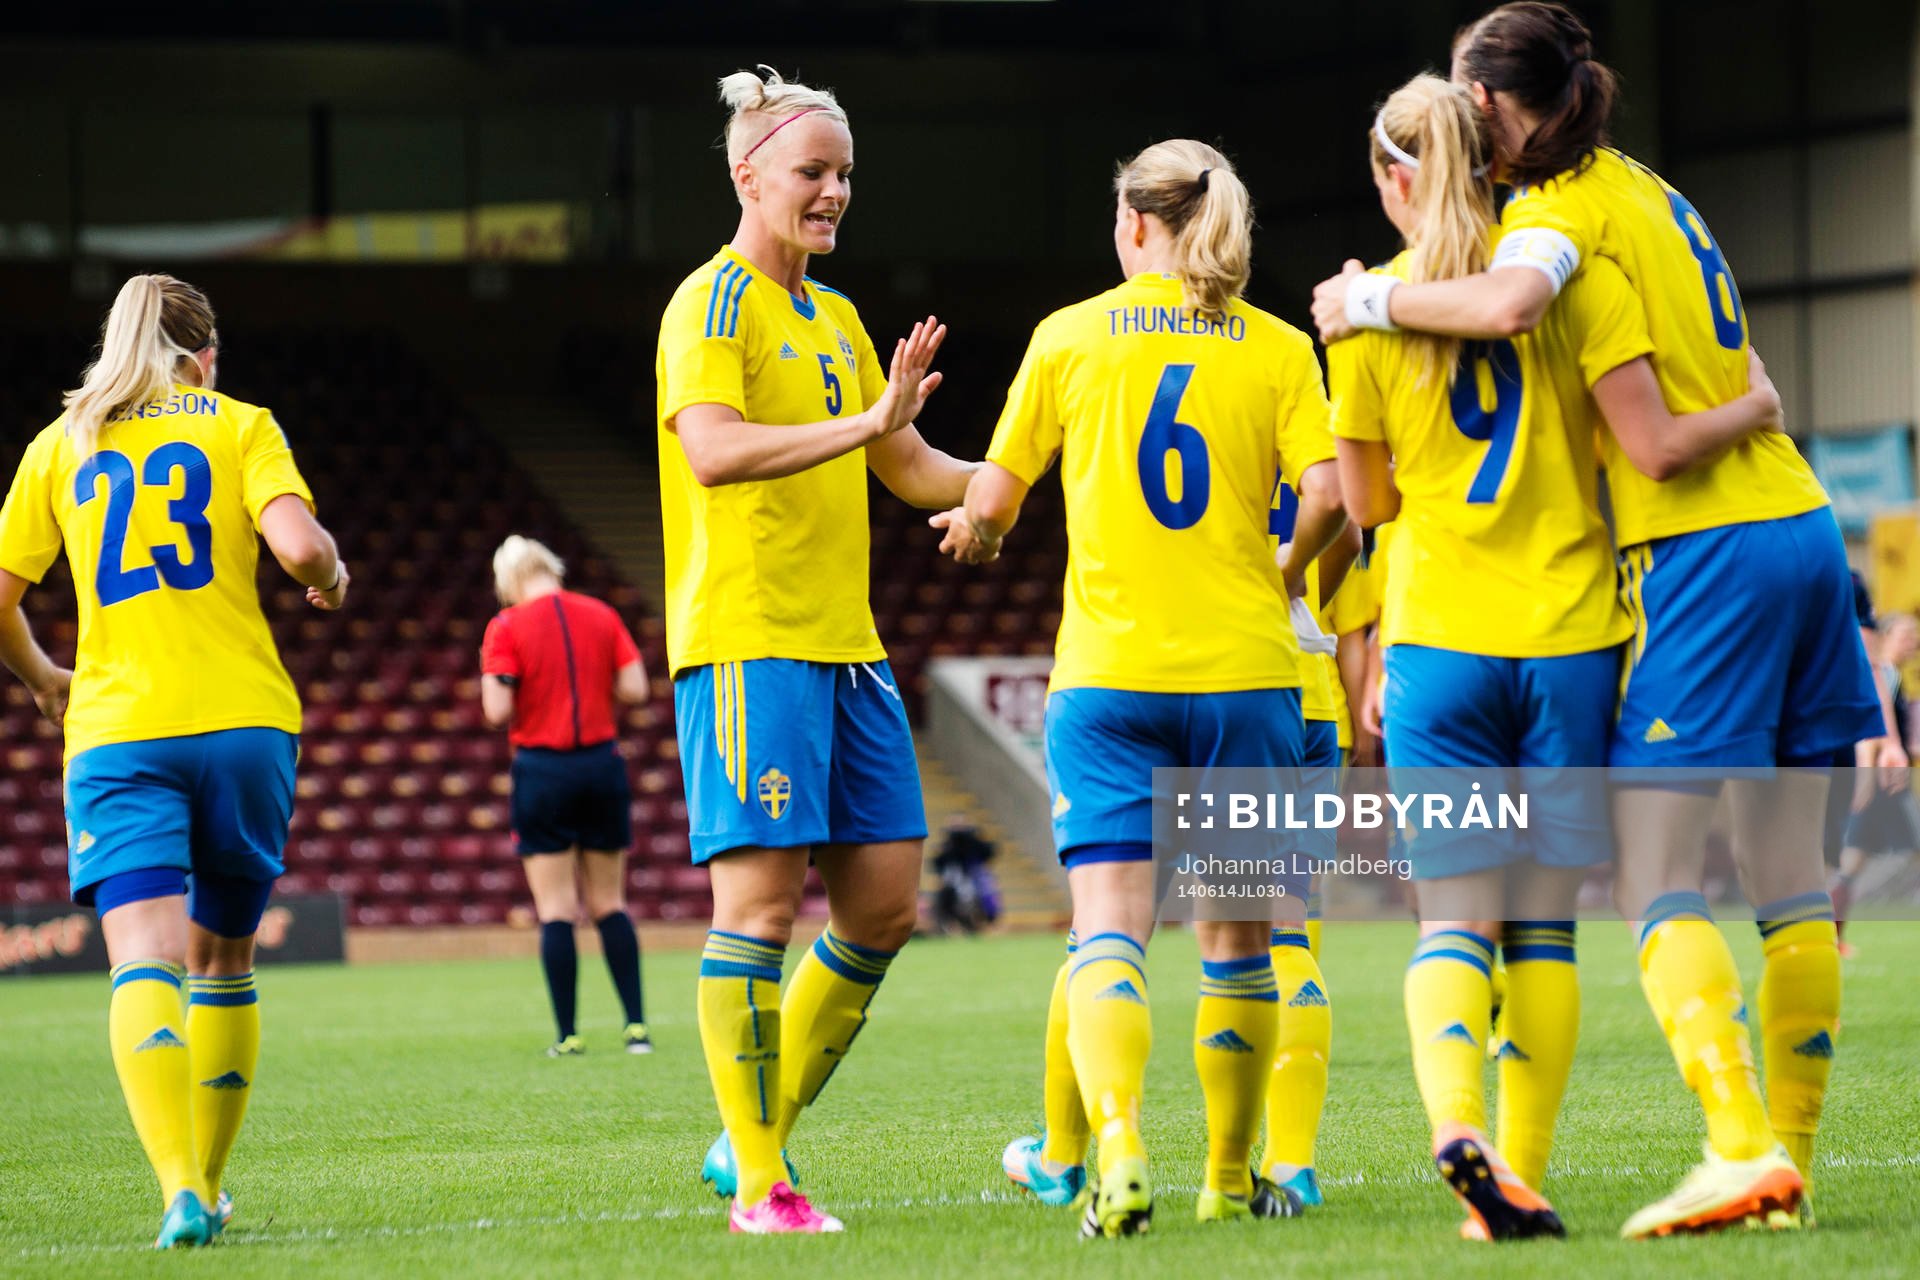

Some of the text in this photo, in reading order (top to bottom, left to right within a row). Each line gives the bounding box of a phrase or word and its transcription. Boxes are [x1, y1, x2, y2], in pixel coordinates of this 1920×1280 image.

[1106, 306, 1246, 343] THUNEBRO
[1670, 192, 1743, 350] 8
[816, 353, 842, 416] 5
[1138, 364, 1210, 530] 6
[1449, 340, 1524, 504] 9
[74, 441, 214, 607] 23
